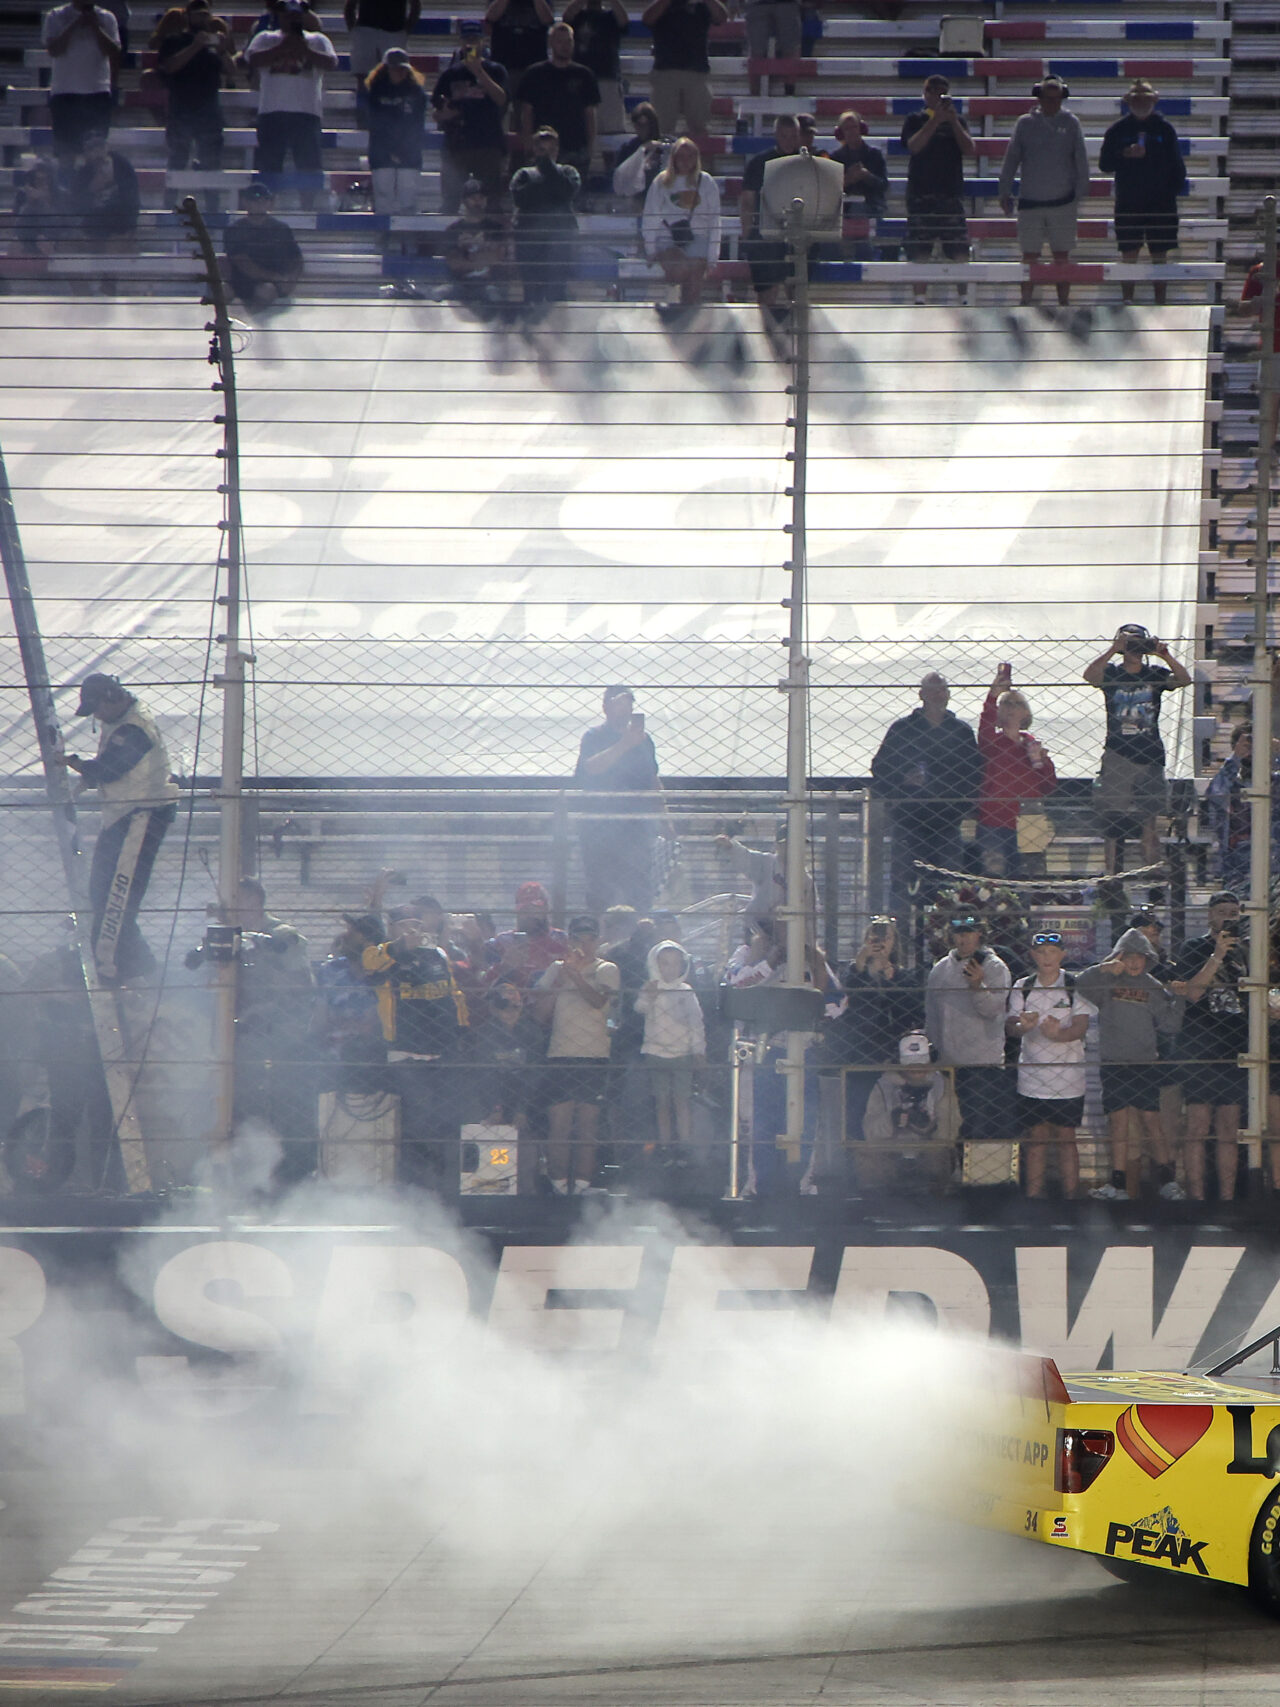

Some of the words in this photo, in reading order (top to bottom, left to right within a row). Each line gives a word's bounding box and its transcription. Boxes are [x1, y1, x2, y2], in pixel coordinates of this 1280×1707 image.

[101, 873, 129, 942] OFFICIAL
[490, 1148, 509, 1165] 25
[1023, 1441, 1049, 1468] APP
[1025, 1510, 1038, 1532] 34
[1104, 1521, 1209, 1576] PEAK
